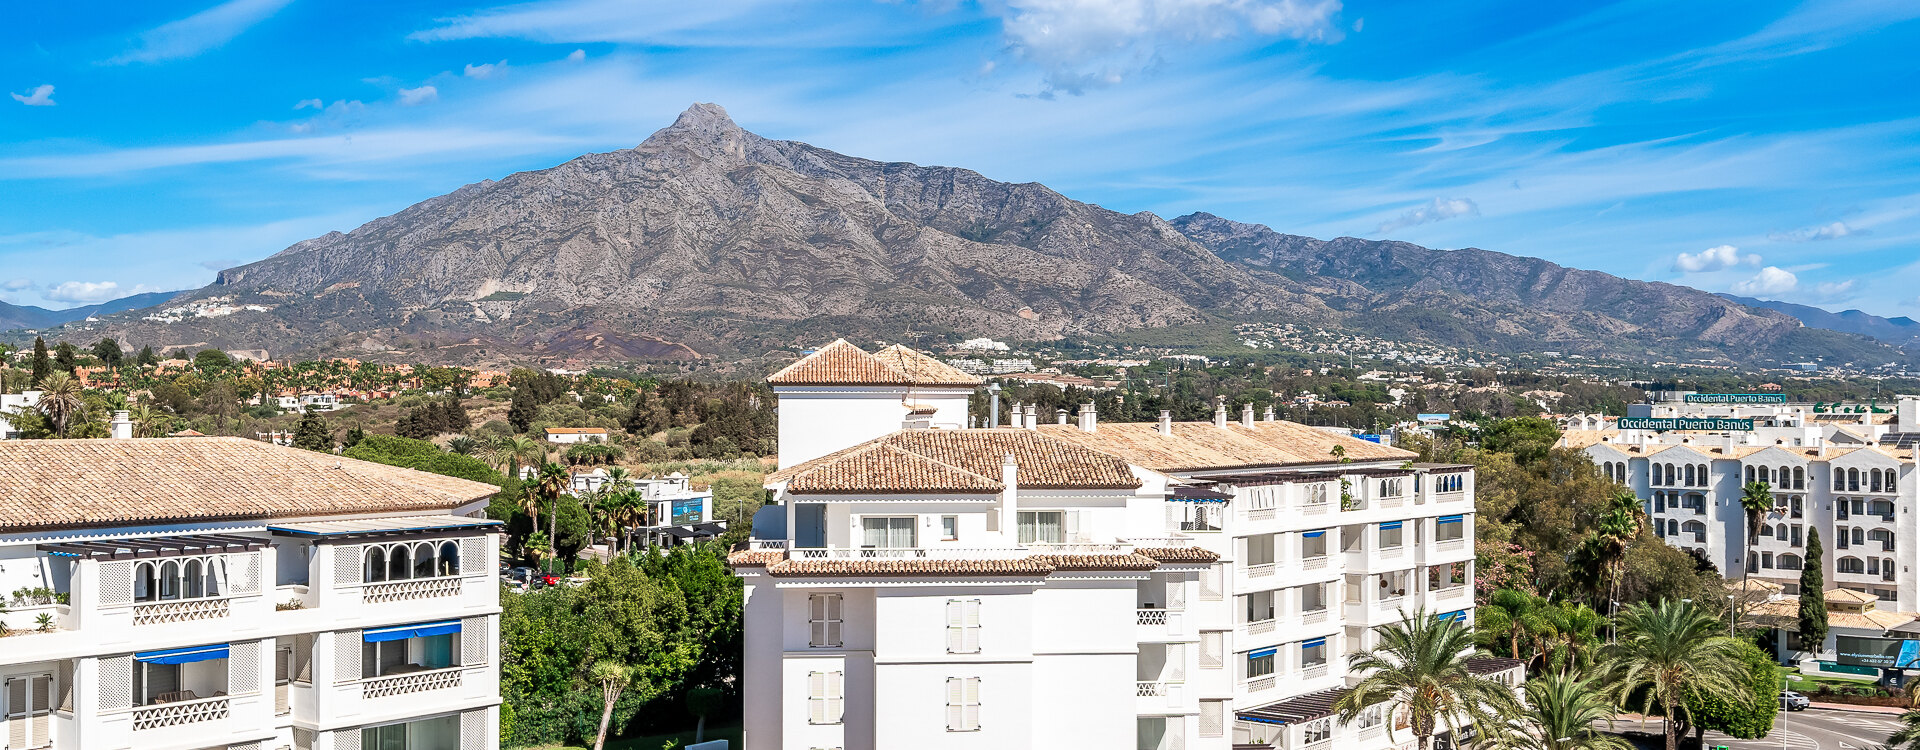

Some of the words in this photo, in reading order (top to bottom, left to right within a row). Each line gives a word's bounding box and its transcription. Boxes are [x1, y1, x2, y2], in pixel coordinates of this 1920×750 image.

[1620, 418, 1676, 429] Occidental
[1679, 419, 1714, 430] Puerto
[1716, 418, 1750, 430] Banús
